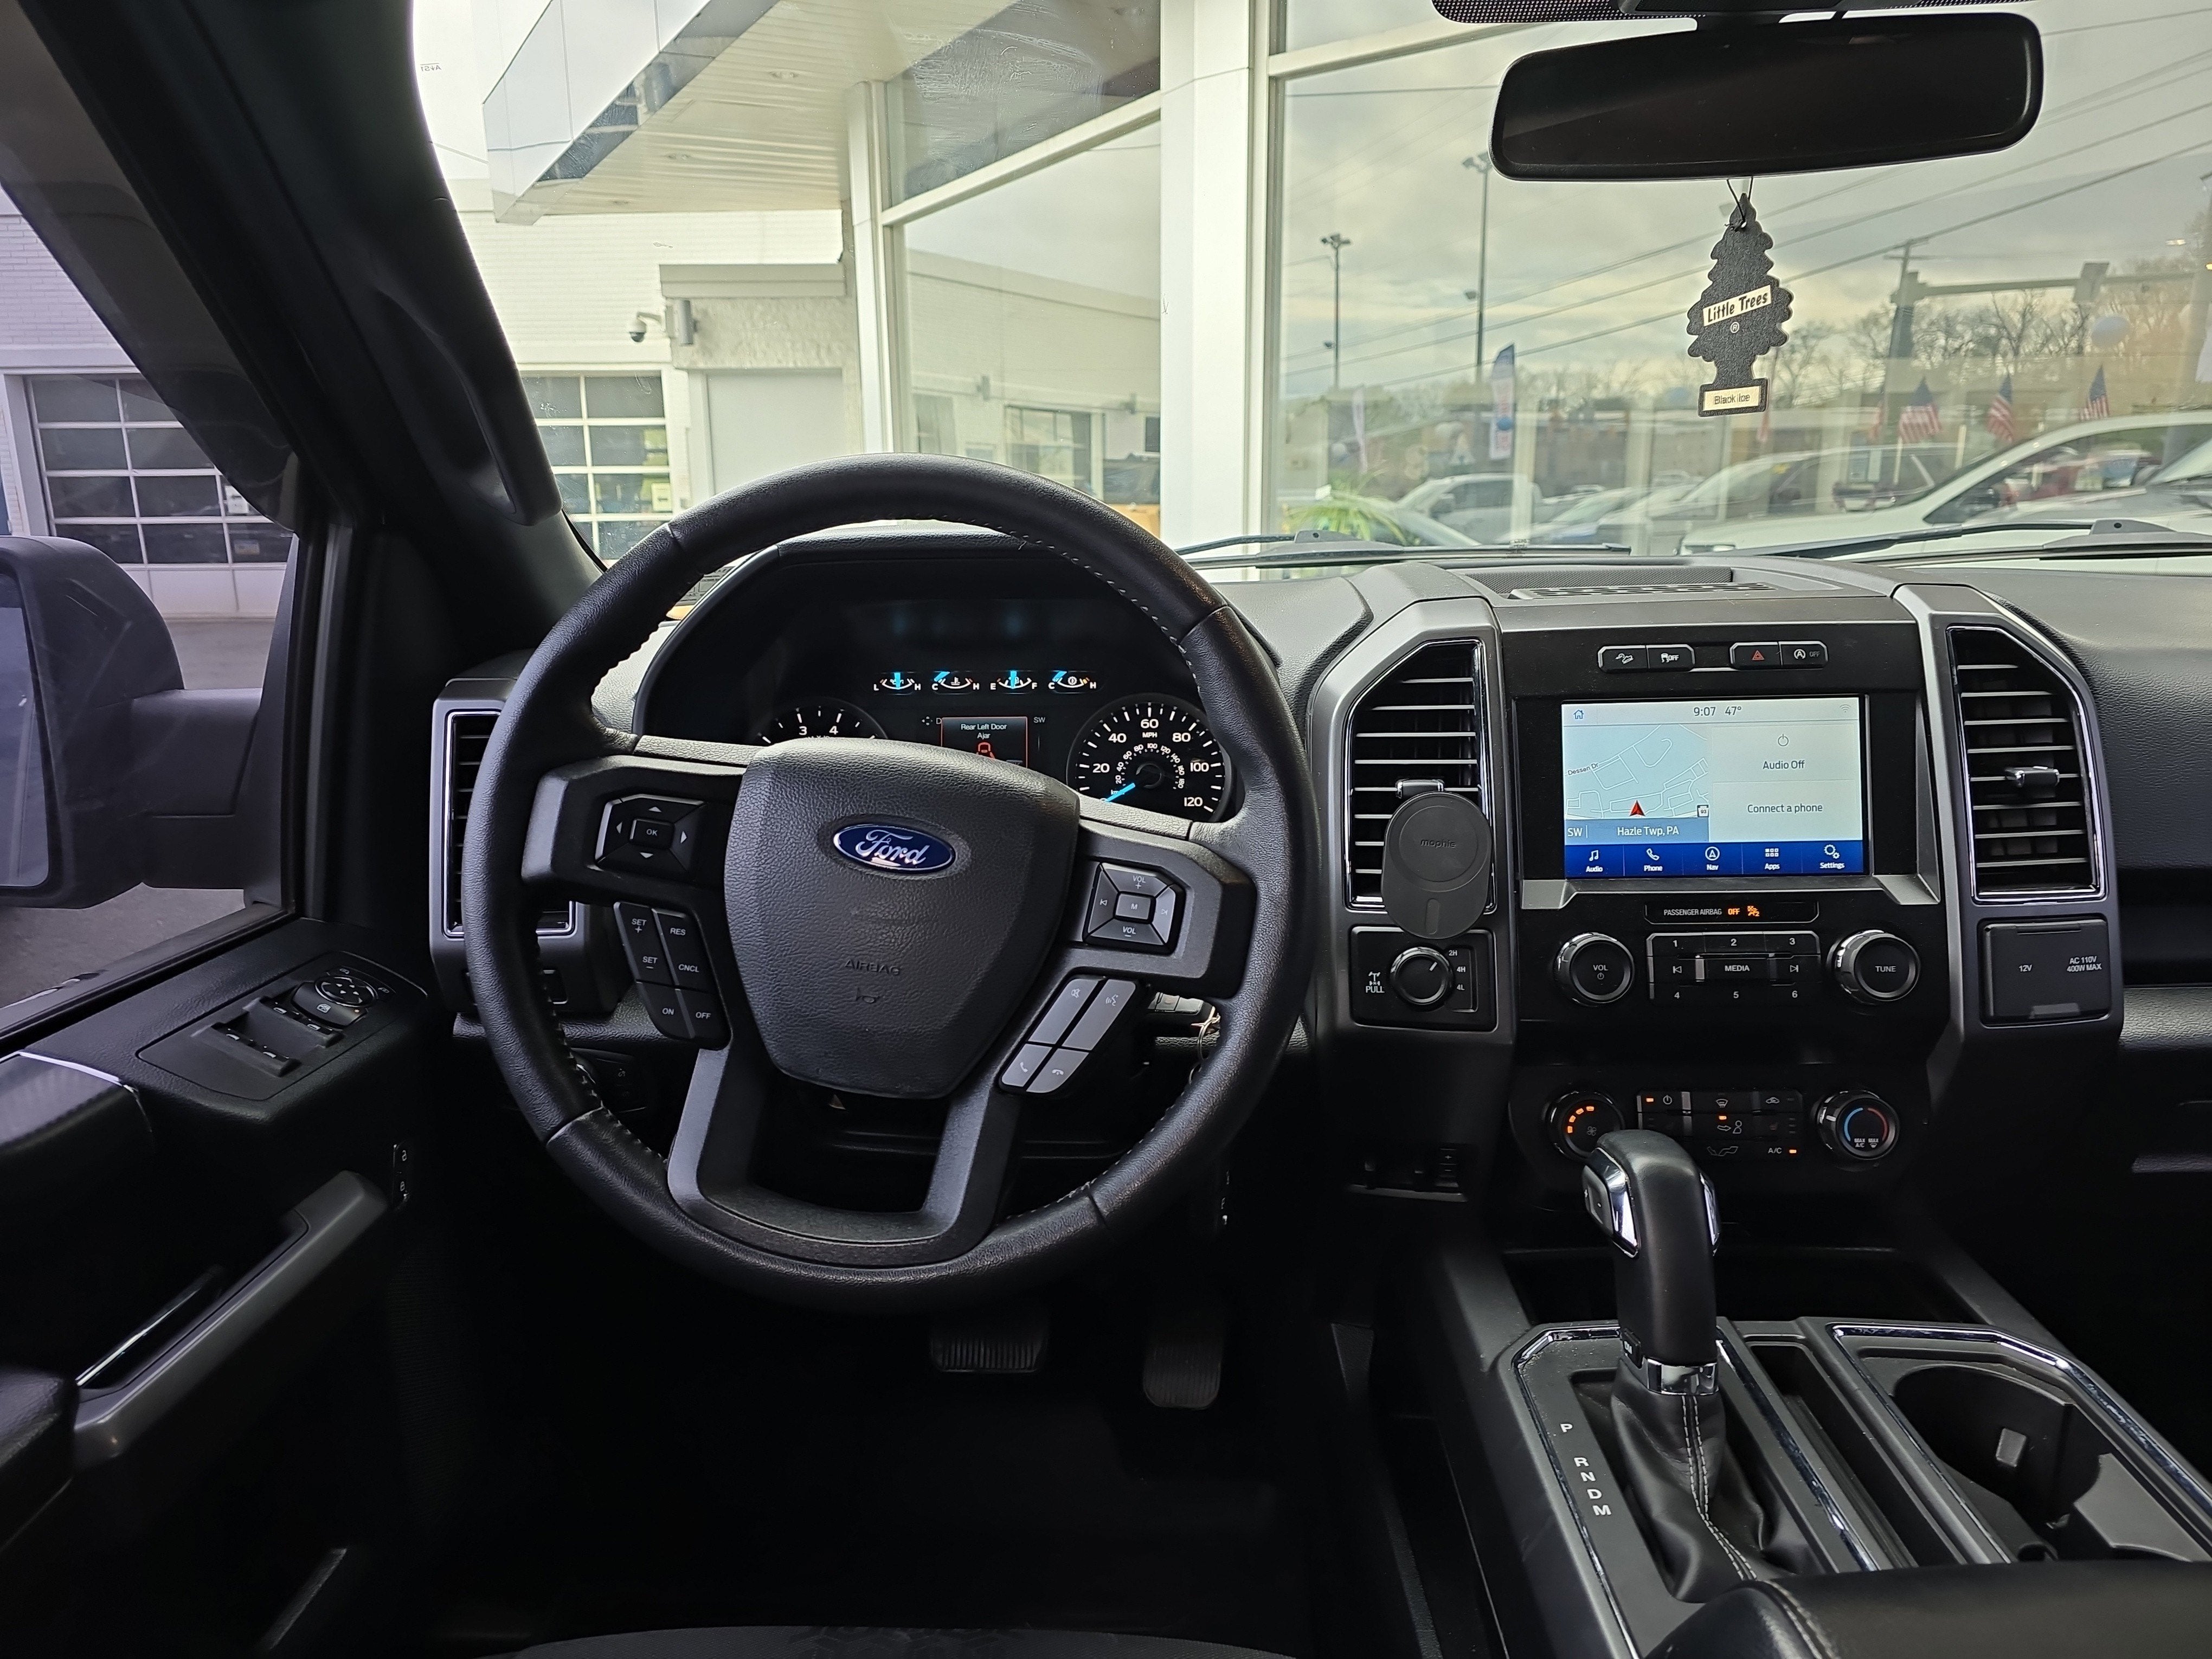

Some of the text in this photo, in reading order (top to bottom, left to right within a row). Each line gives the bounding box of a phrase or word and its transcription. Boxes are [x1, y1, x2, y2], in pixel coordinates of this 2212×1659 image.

[1708, 292, 1767, 323] Little Trees
[1714, 393, 1750, 405] Black Ice
[1693, 707, 1716, 717] 9:07
[1140, 719, 1159, 729] 60
[799, 726, 807, 735] 3
[829, 726, 838, 735] 4
[1108, 733, 1127, 743] 40
[1172, 732, 1191, 742] 80
[1134, 744, 1144, 752] 80
[1161, 745, 1171, 754] 120
[1123, 751, 1133, 760] 60
[1171, 753, 1180, 763] 140
[1092, 763, 1110, 773] 20
[1116, 762, 1124, 772] 40
[1190, 762, 1209, 772] 100
[1763, 760, 1805, 769] Audio Off
[1567, 766, 1591, 776] Dessen
[1115, 775, 1122, 785] 20
[1184, 797, 1203, 807] 120
[1747, 804, 1785, 813] Connect
[1794, 803, 1823, 813] phone
[1567, 827, 1583, 837] SW
[1617, 826, 1679, 837] Hazle Twp, PA
[856, 829, 930, 865] Ford
[1420, 839, 1456, 849] mophie
[1133, 876, 1146, 884] VOL
[670, 928, 686, 936] RES
[1122, 927, 1136, 935] VOL
[642, 956, 658, 964] SET
[678, 963, 699, 973] CNCL
[844, 959, 901, 976] AIRBAG
[2019, 964, 2033, 972] 12V
[2086, 963, 2102, 971] MAX
[1560, 1423, 1573, 1432] P
[1574, 1457, 1590, 1467] R
[1580, 1471, 1596, 1482] N
[1587, 1489, 1602, 1499] D
[1592, 1504, 1612, 1515] M
